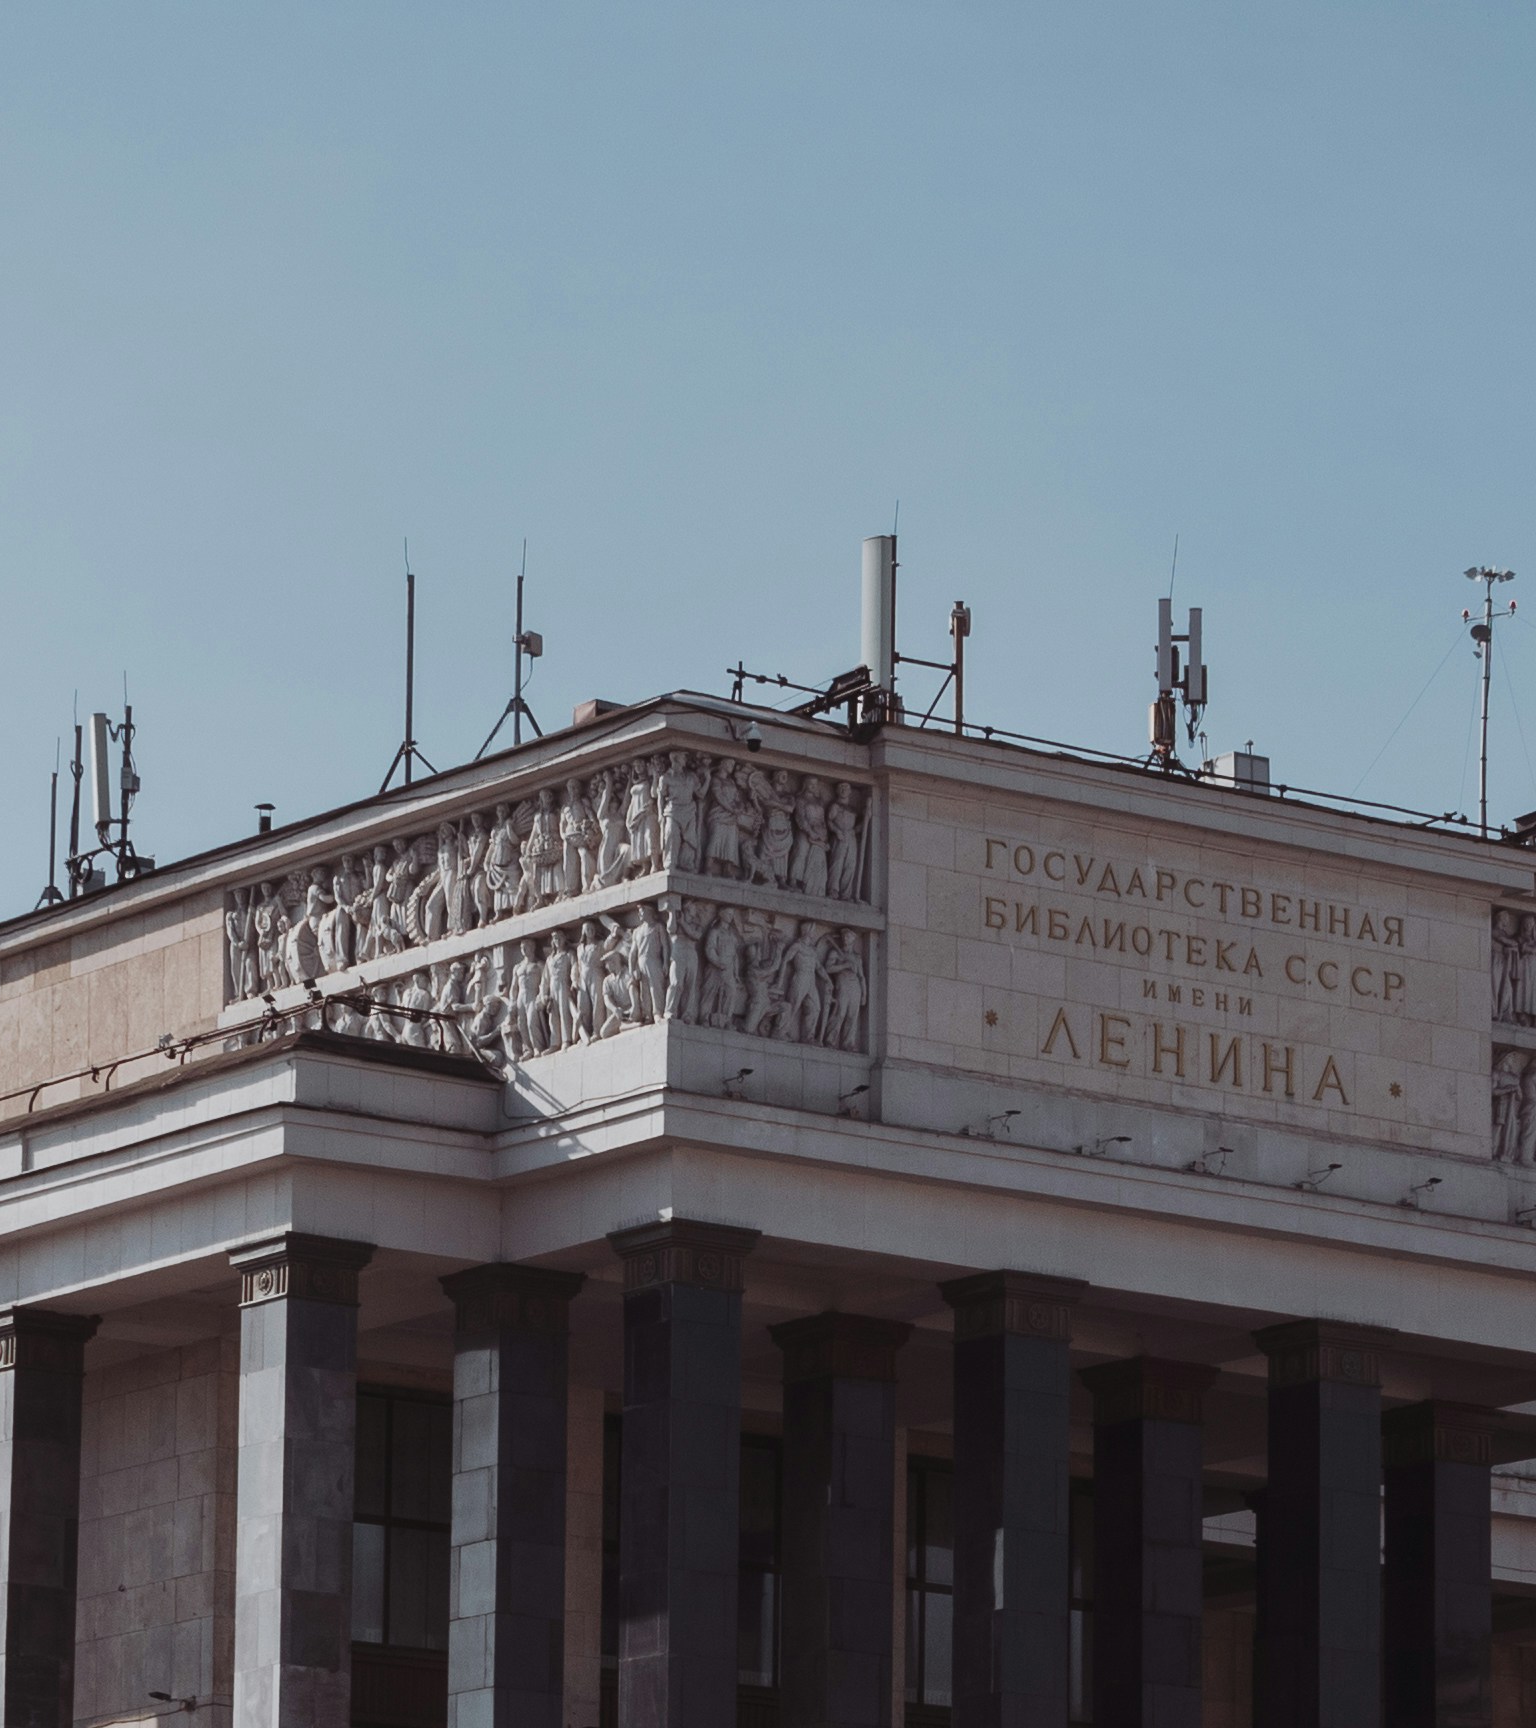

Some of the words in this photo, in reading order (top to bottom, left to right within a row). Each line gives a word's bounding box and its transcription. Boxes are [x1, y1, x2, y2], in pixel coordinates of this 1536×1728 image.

[985, 838, 1405, 948] ГОСУДАРСТВЕННАЯ
[985, 896, 1264, 978] БИБЛИОТЕКА
[1142, 979, 1253, 1017] ИМЕНИ
[1041, 1006, 1351, 1106] ЛЕНИНА
